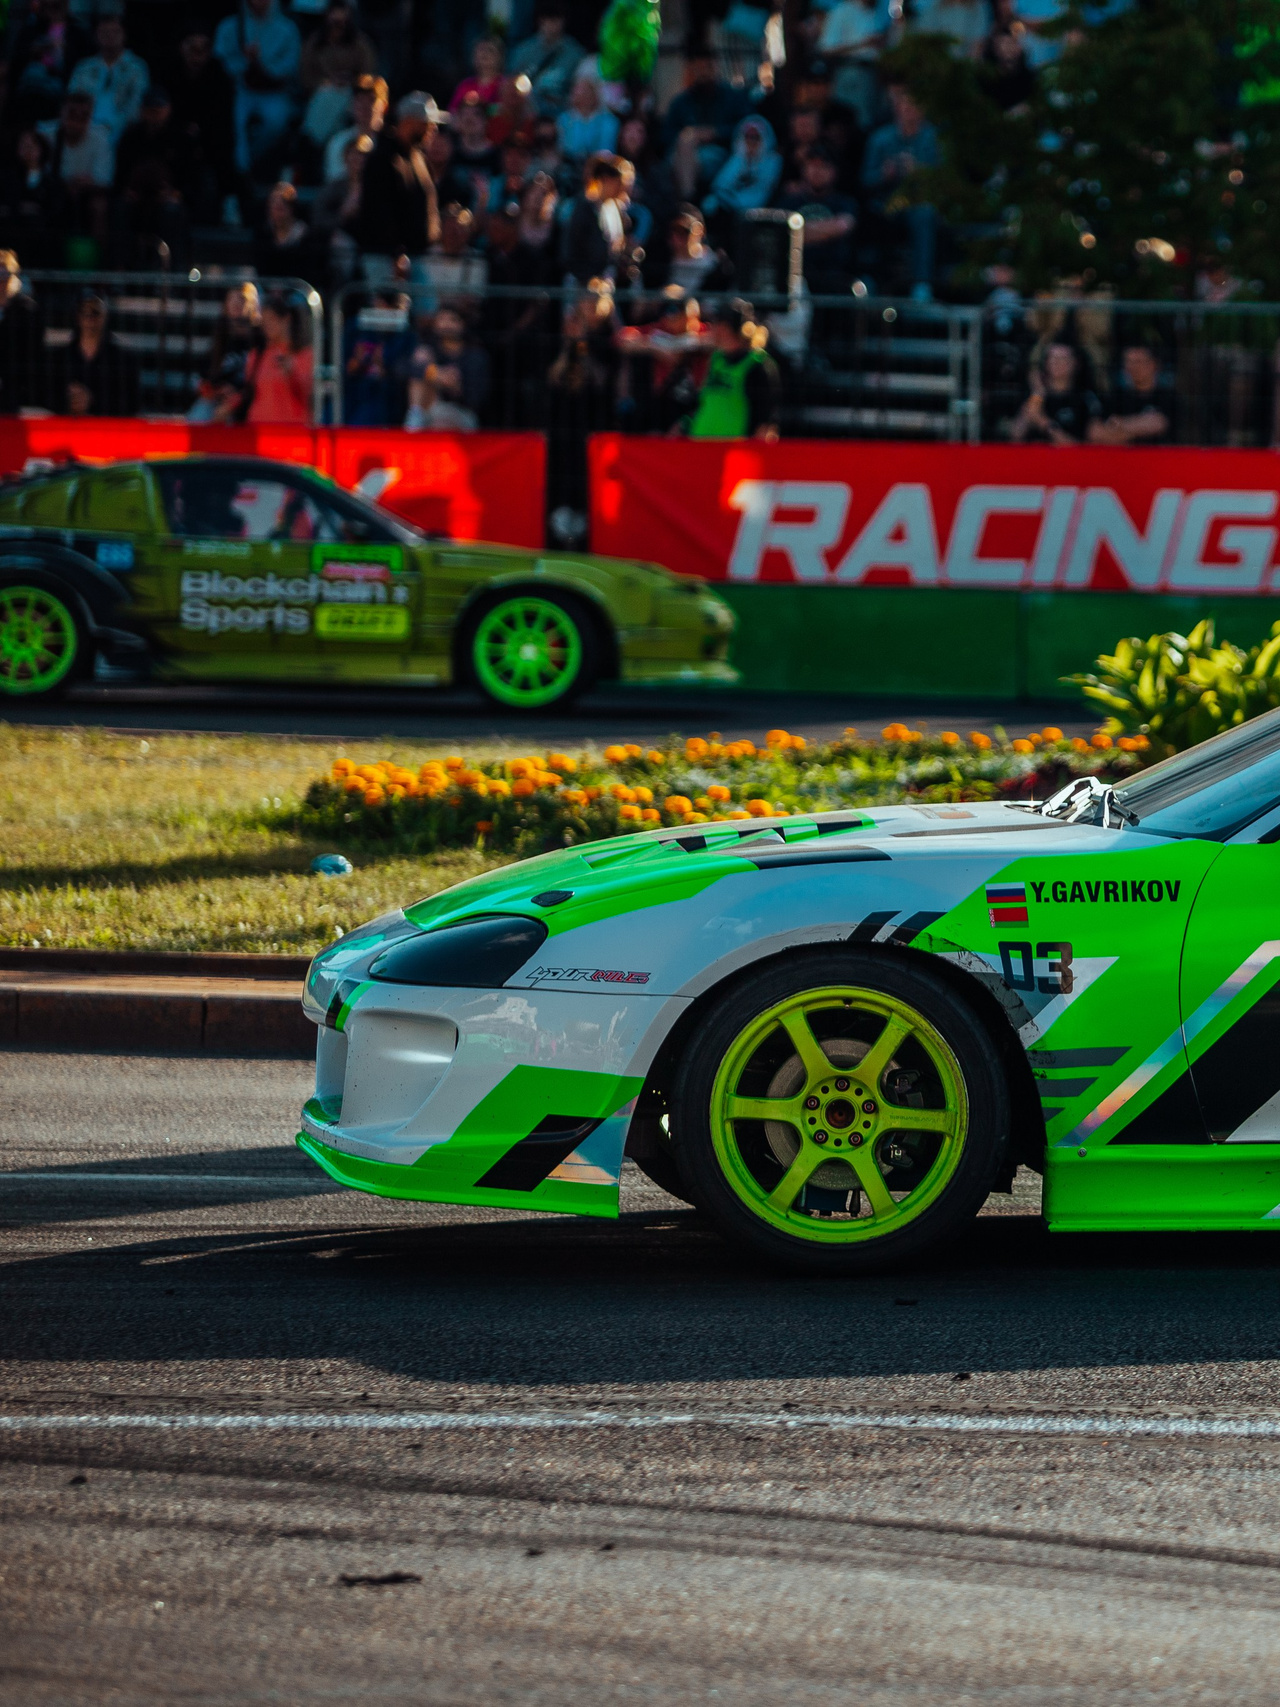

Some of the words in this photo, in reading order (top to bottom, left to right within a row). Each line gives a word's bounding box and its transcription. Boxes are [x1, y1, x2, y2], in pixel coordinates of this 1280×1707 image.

[181, 570, 388, 604] Blockchain
[180, 598, 310, 636] Sports
[1030, 880, 1181, 903] Y.GAVRIKOV
[998, 941, 1074, 994] 03
